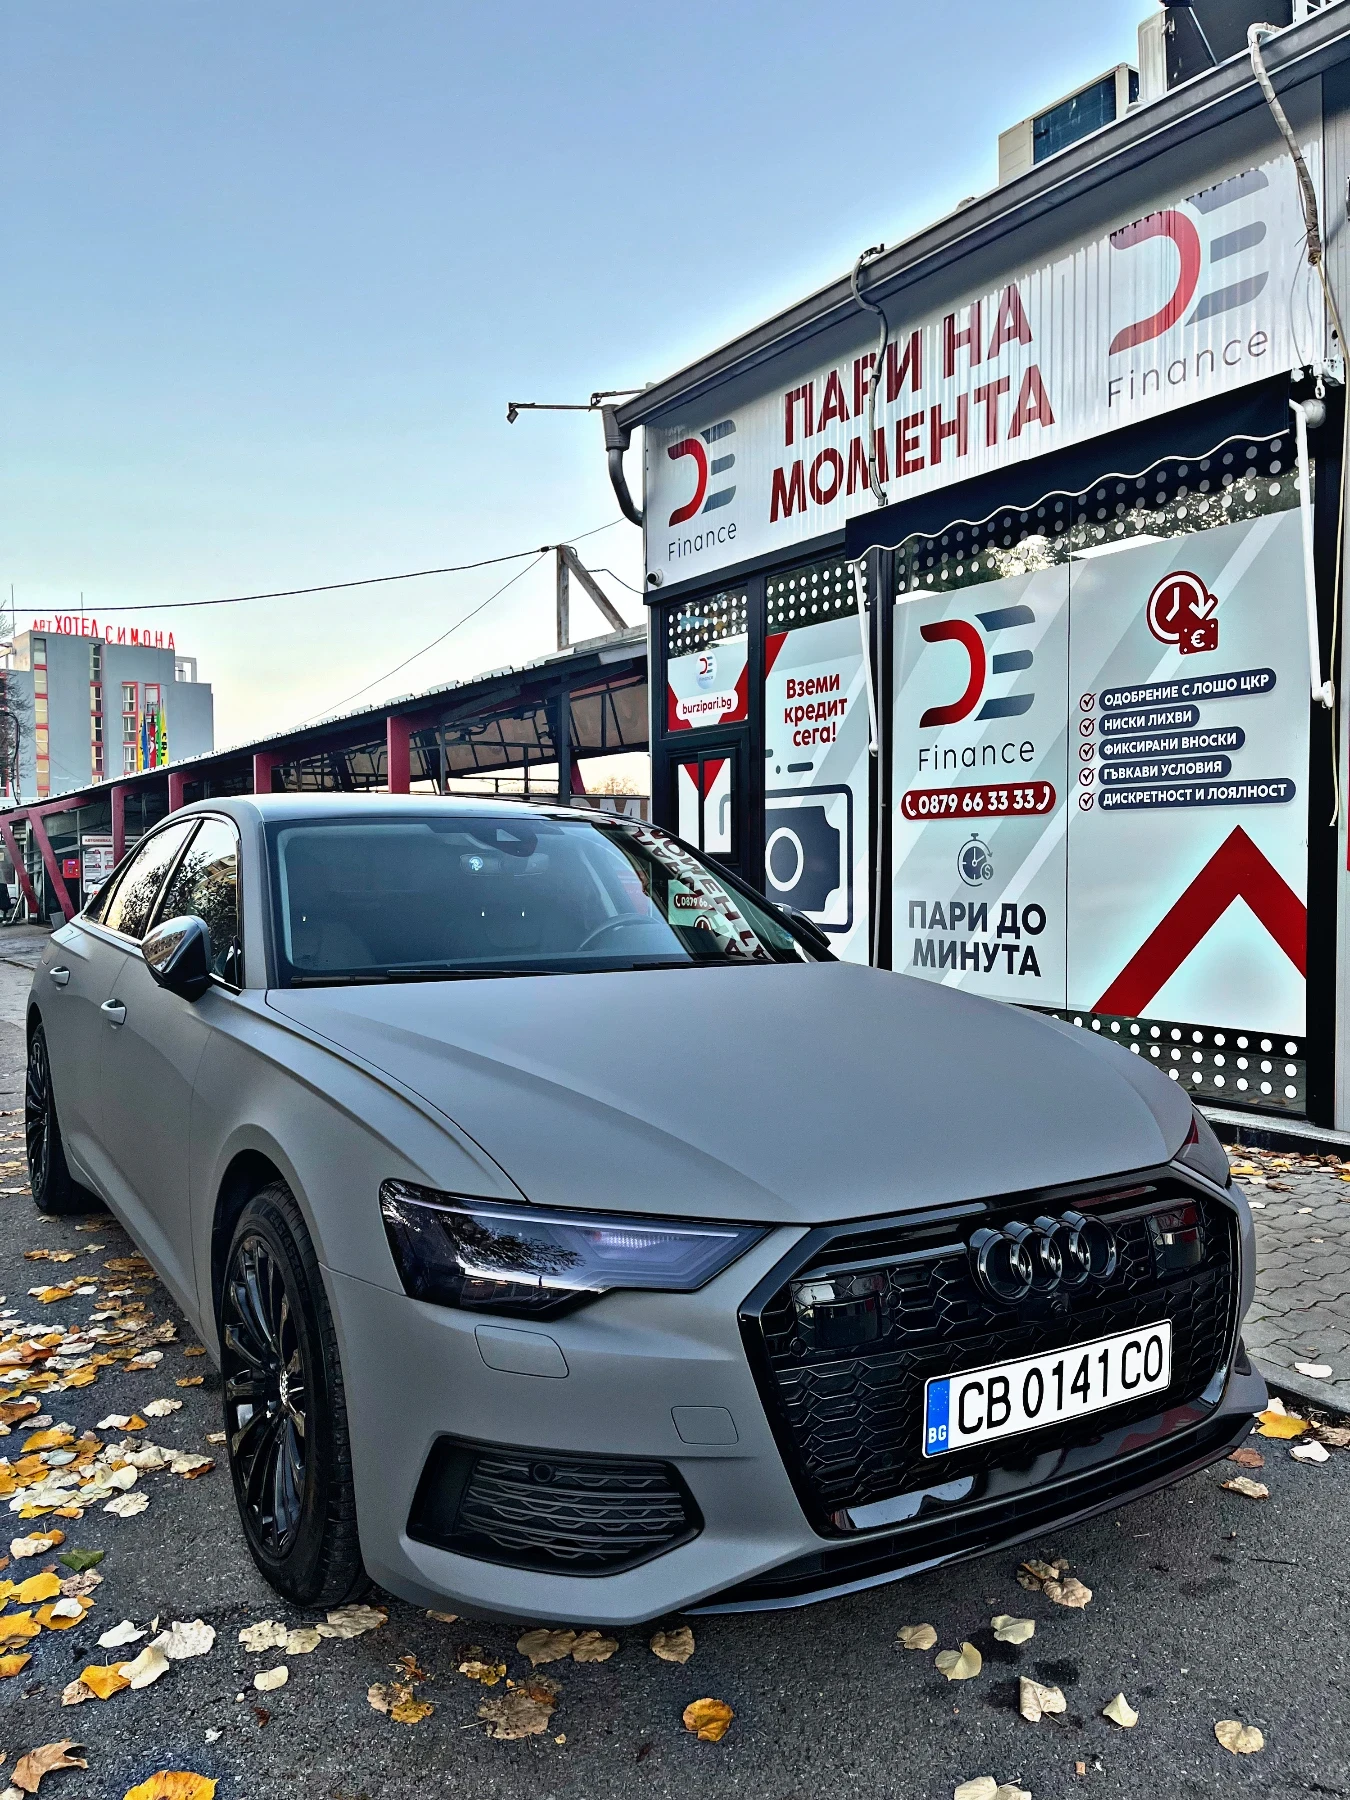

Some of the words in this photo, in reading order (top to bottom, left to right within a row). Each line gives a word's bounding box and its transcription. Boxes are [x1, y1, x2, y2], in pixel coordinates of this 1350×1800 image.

[785, 328, 922, 447] ПАРИ
[943, 283, 1033, 379] НА
[1109, 328, 1269, 407] Finance
[770, 364, 1055, 523] МОМЕНТА
[668, 519, 737, 562] Finance
[33, 619, 52, 632] АРТ
[55, 614, 99, 639] ХОТЕЛ
[105, 625, 175, 650] СИМОНА
[786, 672, 840, 699] Вземи
[1104, 685, 1178, 707] ОДОБРЕНИЕ
[1181, 684, 1190, 696] С
[1192, 678, 1238, 696] ЛОШО
[1240, 674, 1269, 692] ЦКР
[682, 697, 732, 715] burzipari.bg
[784, 697, 847, 725] кредит
[1104, 716, 1146, 731] НИСКИ
[1147, 710, 1192, 727] ЛИХВИ
[792, 722, 837, 747] сега!
[1104, 737, 1179, 755] ФИКСИРАНИ
[1181, 732, 1237, 749] ВНОСКИ
[919, 739, 1035, 772] Finance
[1103, 765, 1159, 780] ГЪВКАВИ
[1161, 760, 1222, 777] УСЛОВИЯ
[918, 786, 958, 814] 0879
[962, 785, 984, 812] 66
[987, 784, 1009, 811] 33
[1013, 783, 1035, 810] 33
[1103, 789, 1192, 807] ДИСКРЕТНОСТ
[1195, 789, 1204, 800] И
[1206, 783, 1287, 800] ЛОЯЛНОСТ
[908, 900, 988, 932] ПАРИ
[996, 903, 1047, 938] ДО
[912, 938, 1042, 978] МИНУТА
[958, 1373, 1010, 1435] CB
[1022, 1346, 1109, 1419] 0141
[1121, 1333, 1163, 1390] CO
[928, 1425, 947, 1442] BG
